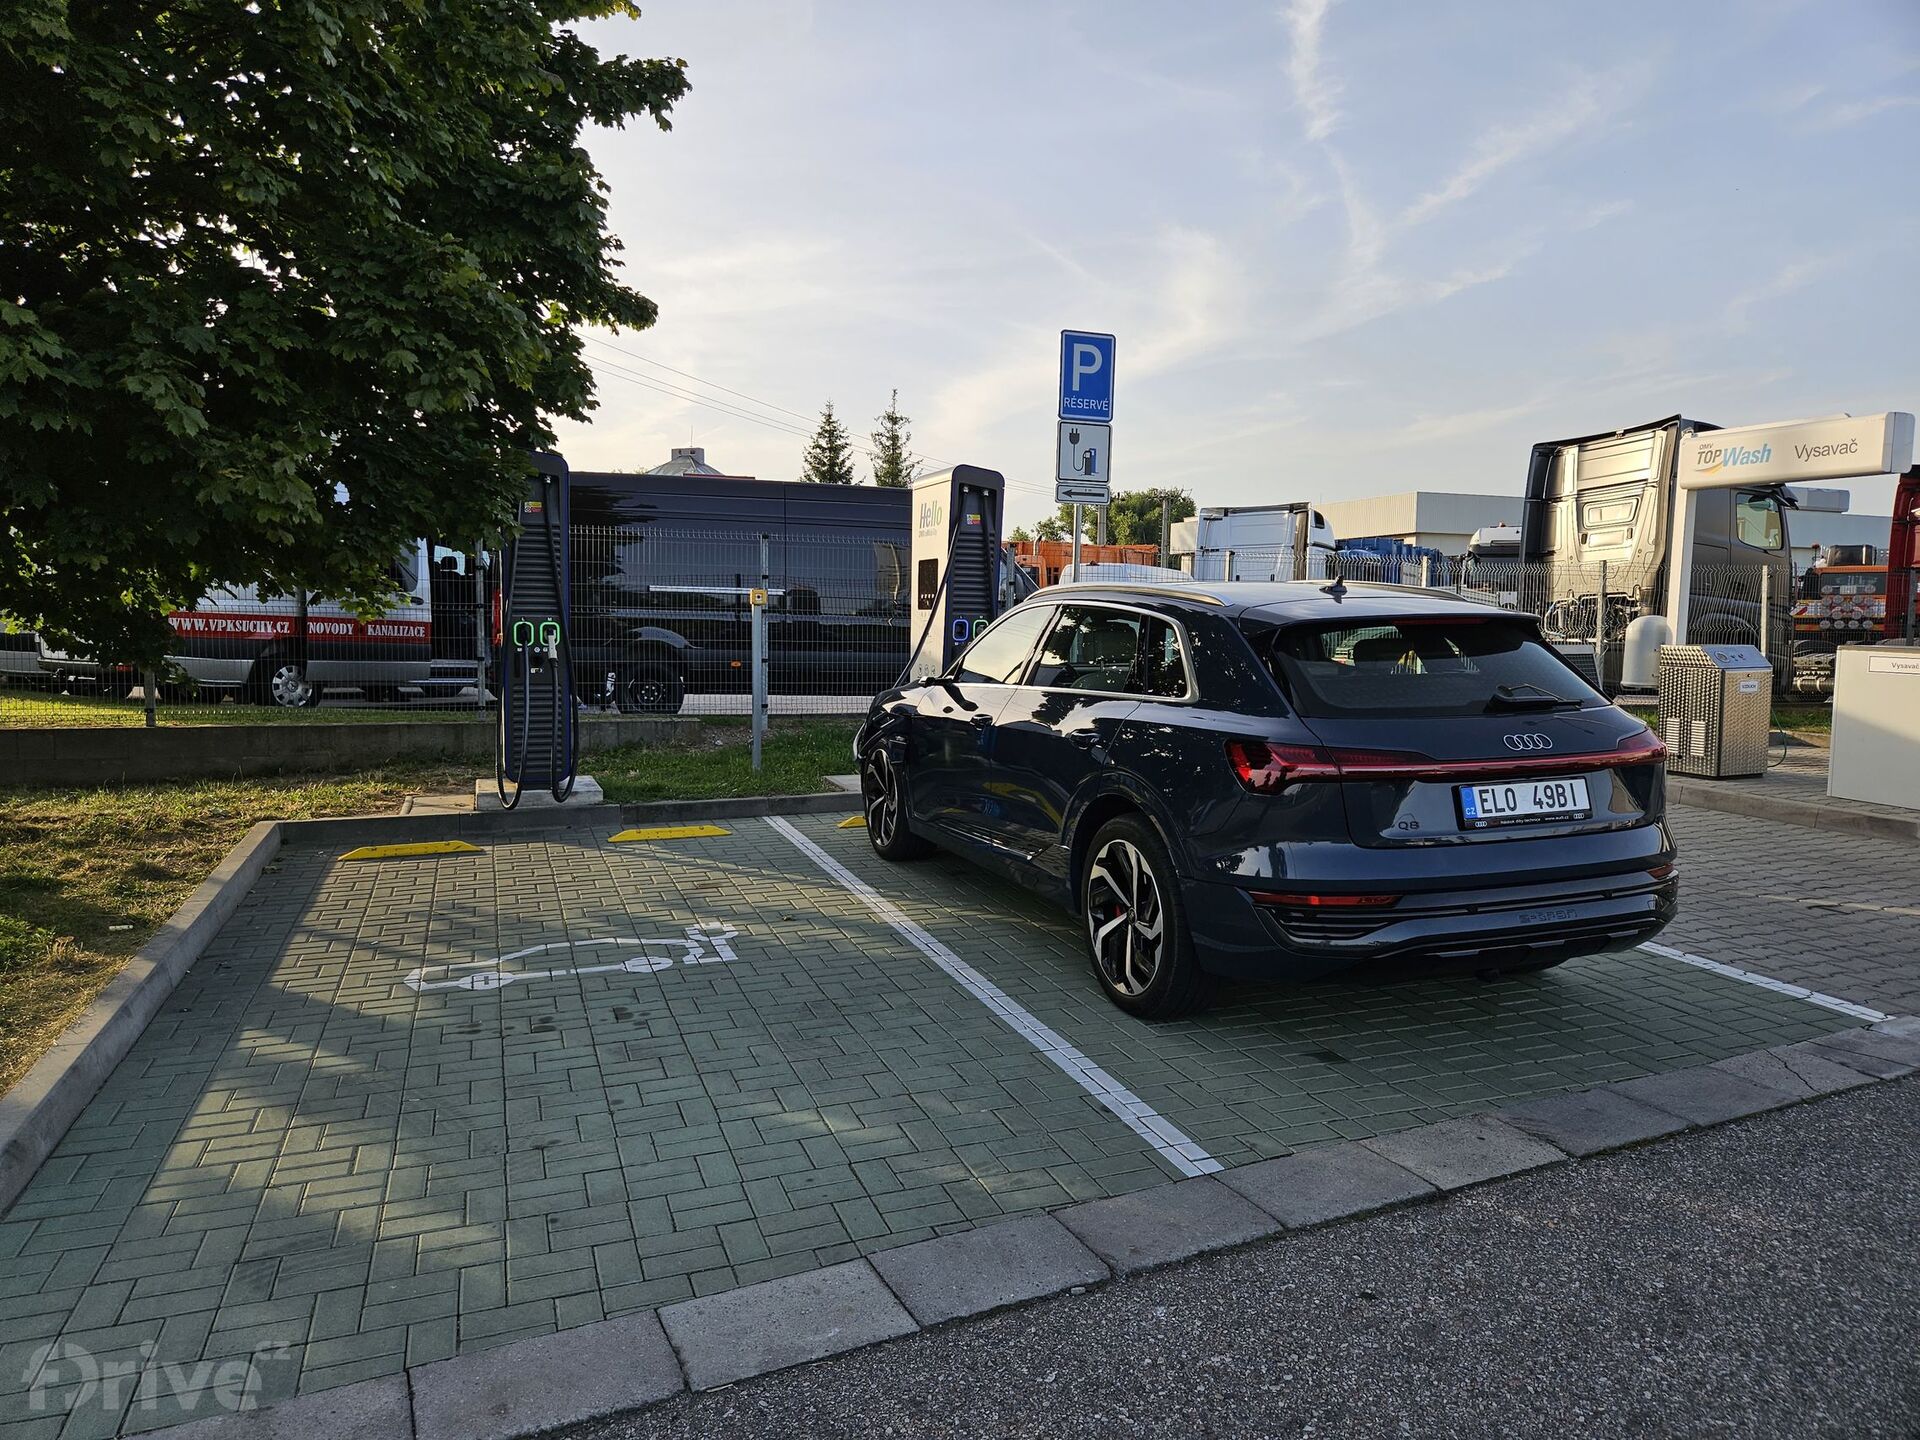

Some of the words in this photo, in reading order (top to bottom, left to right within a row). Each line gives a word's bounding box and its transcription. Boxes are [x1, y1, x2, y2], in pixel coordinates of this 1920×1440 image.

[1072, 343, 1103, 392] P
[1063, 395, 1109, 411] RÉSERVÉ
[1794, 438, 1859, 462] Vysavač
[919, 500, 943, 529] Hello
[367, 624, 426, 638] KANALIZACE
[1465, 807, 1477, 816] CZ
[1398, 821, 1420, 831] Q8
